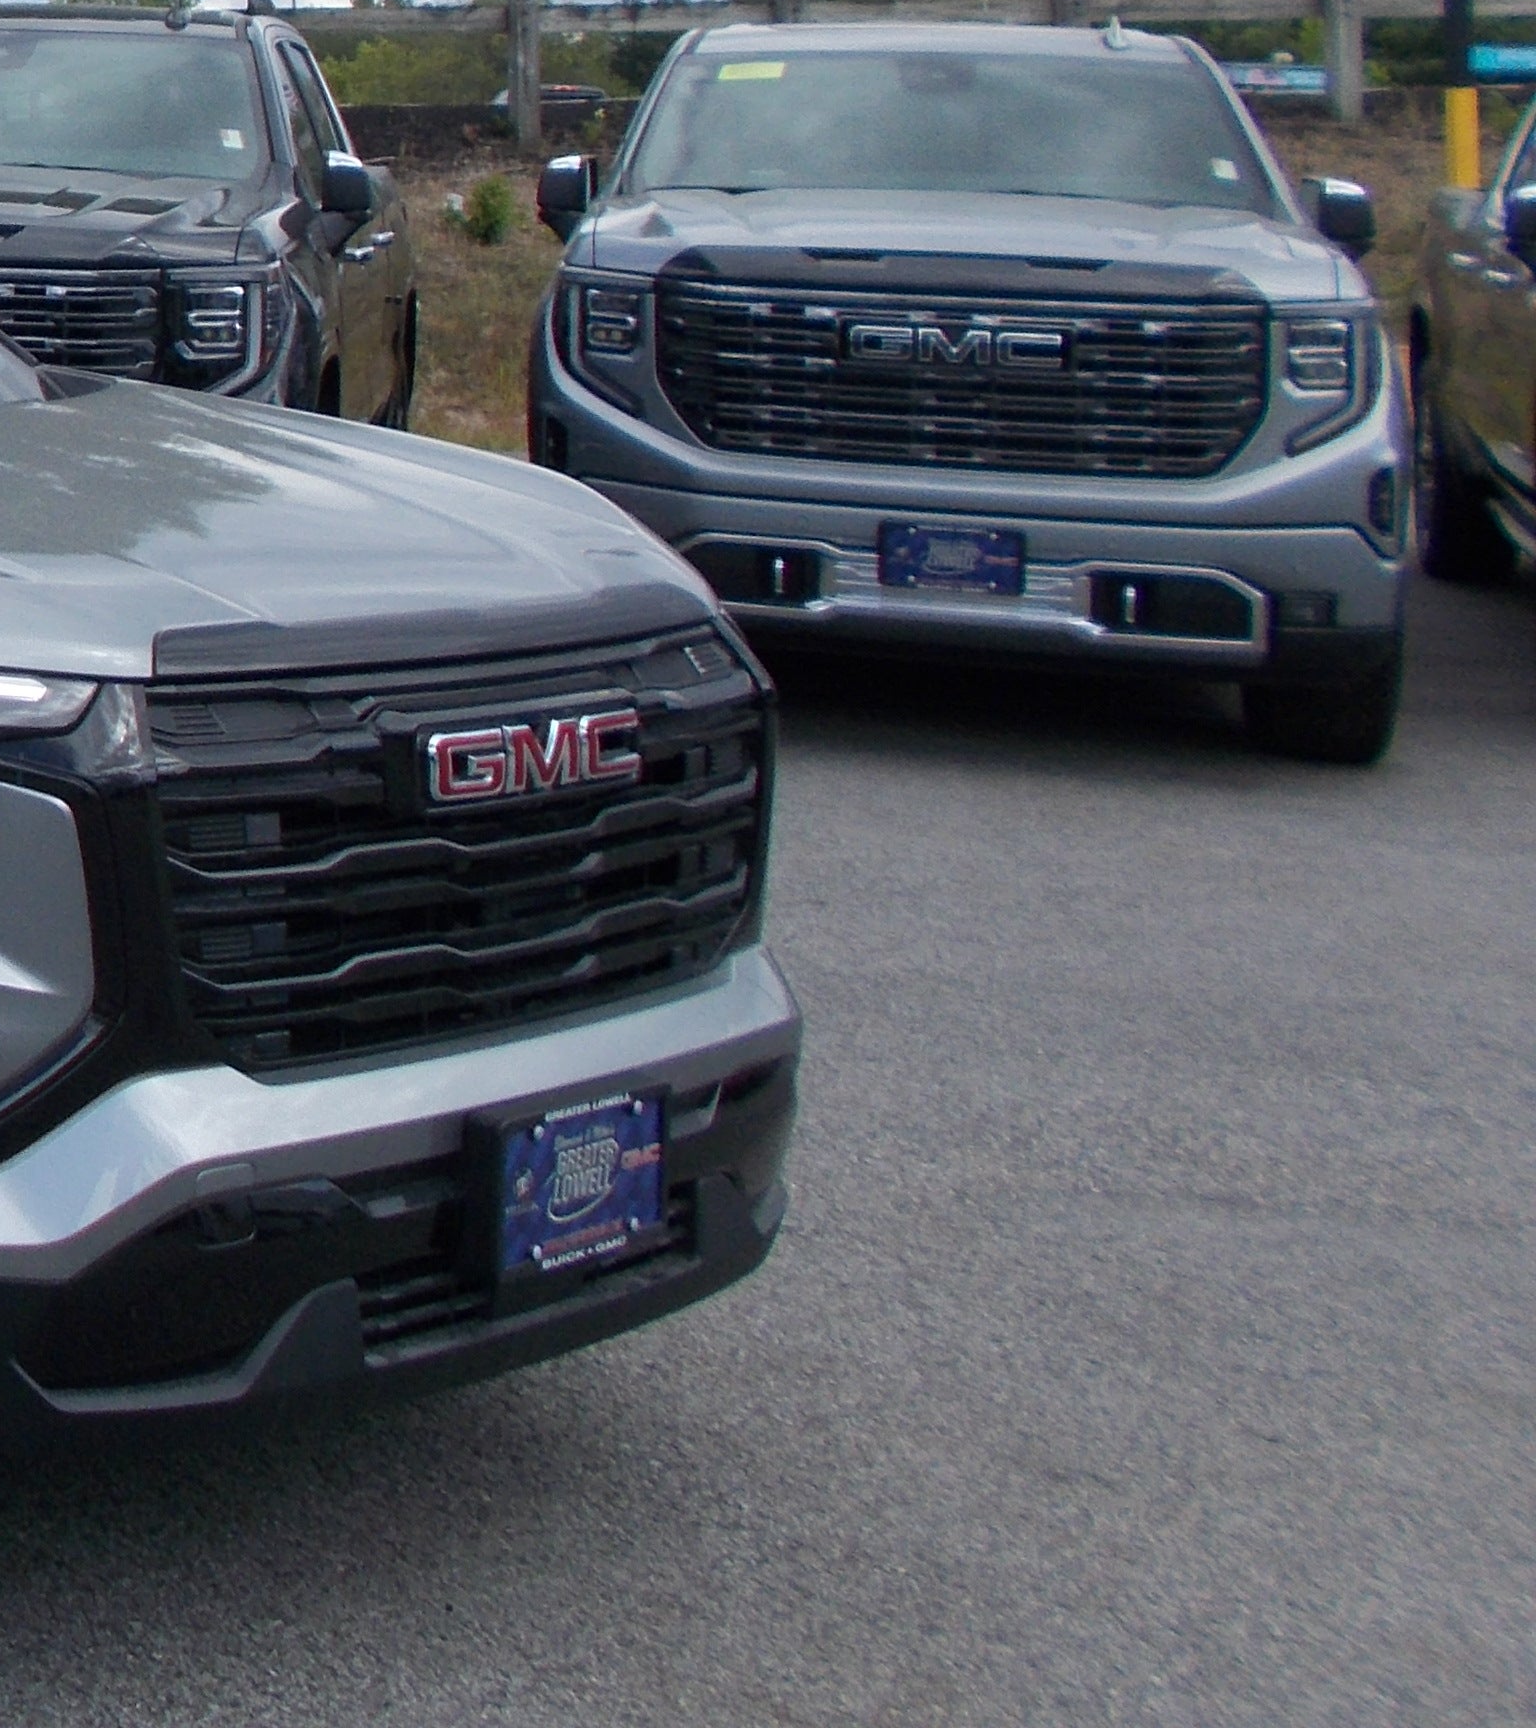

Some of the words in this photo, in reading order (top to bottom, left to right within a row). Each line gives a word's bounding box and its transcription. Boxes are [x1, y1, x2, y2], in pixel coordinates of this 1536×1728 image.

[850, 324, 1062, 368] GMC
[428, 707, 640, 801] GMC
[545, 1103, 591, 1122] GREATER
[592, 1093, 631, 1110] LOWELL
[554, 1165, 614, 1206] LOWELL
[542, 1245, 586, 1270] BUICK
[595, 1235, 627, 1254] GMC
